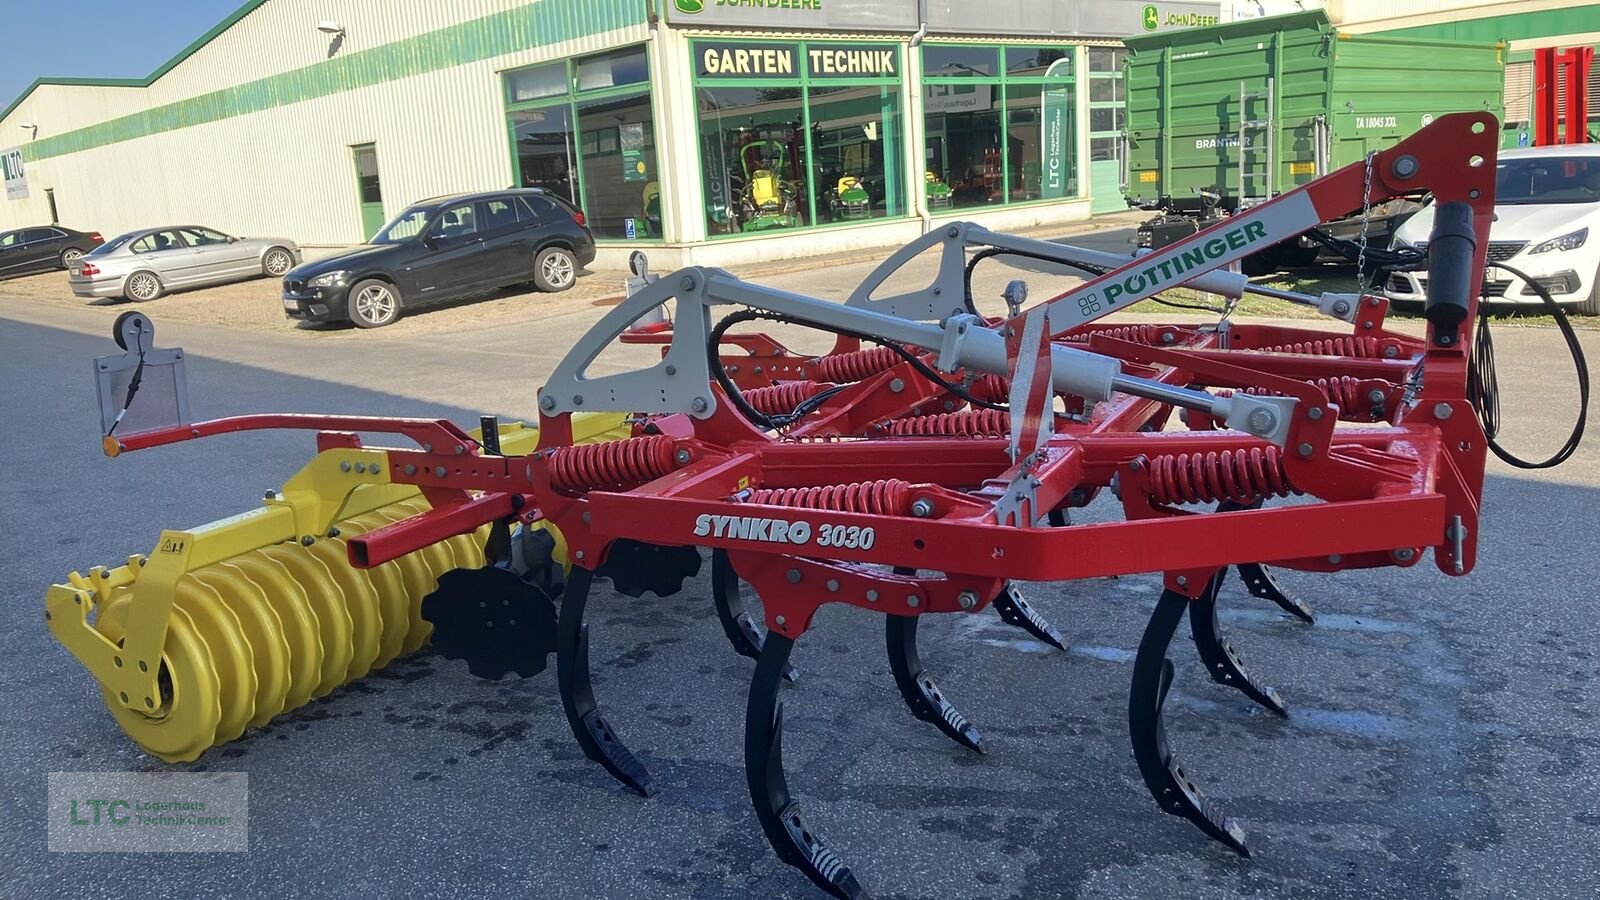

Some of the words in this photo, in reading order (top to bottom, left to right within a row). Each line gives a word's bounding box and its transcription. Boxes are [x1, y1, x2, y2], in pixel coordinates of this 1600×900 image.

[1164, 11, 1189, 26] JOHN
[1189, 12, 1218, 27] DEERE
[704, 48, 792, 74] GARTEN
[809, 50, 895, 73] TECHNIK
[1356, 117, 1364, 129] TA
[1384, 116, 1397, 128] XXL
[1196, 137, 1250, 149] BRANTNR
[6, 150, 24, 180] LTC
[1049, 158, 1059, 188] LTC
[1103, 219, 1268, 305] PÖTTINGER
[693, 513, 812, 545] SYNKRO
[816, 523, 875, 551] 3030
